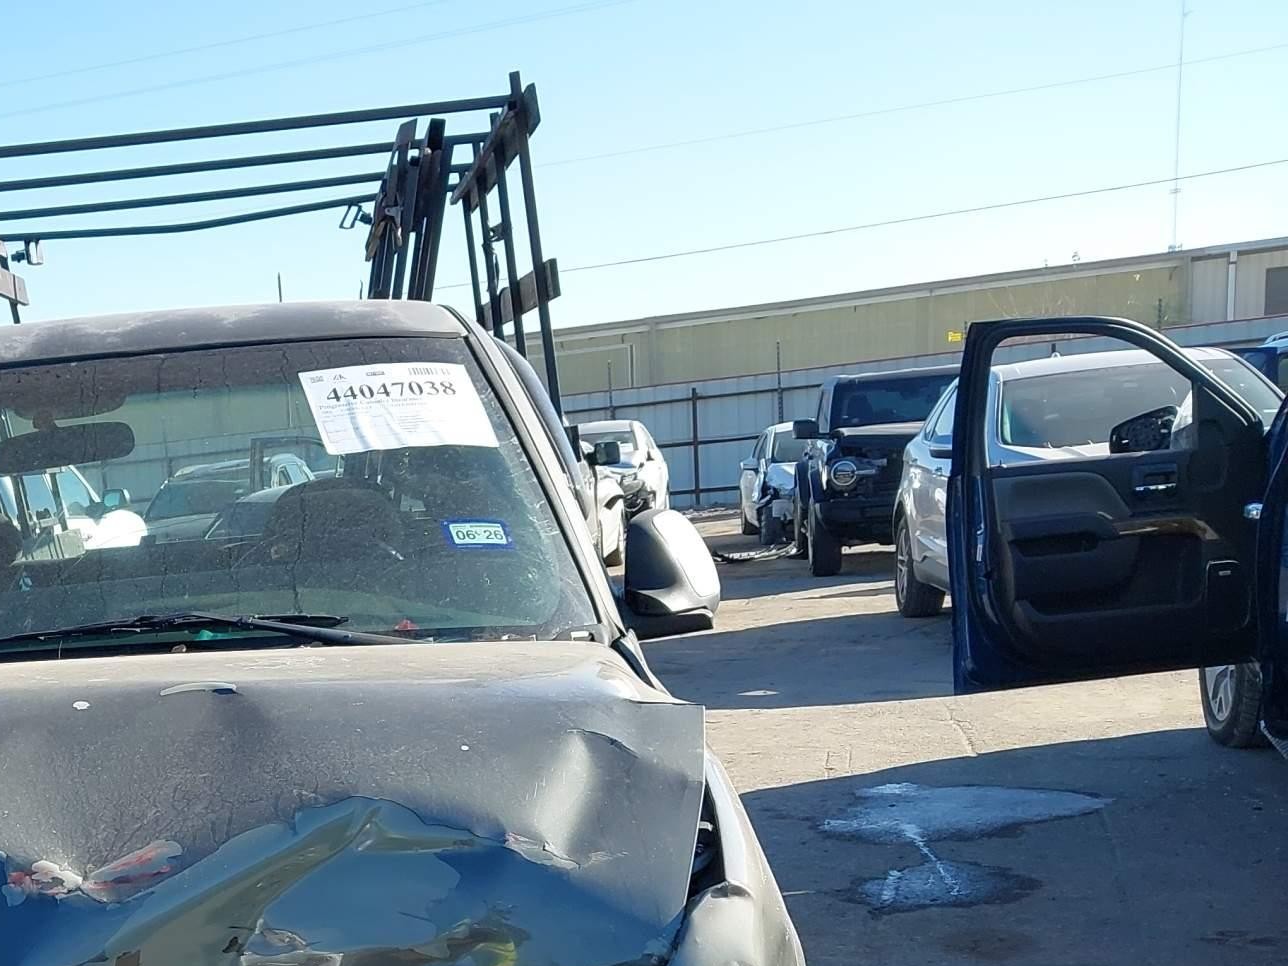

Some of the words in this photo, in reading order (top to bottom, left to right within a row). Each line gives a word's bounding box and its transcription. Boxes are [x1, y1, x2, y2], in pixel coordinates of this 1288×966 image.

[326, 380, 457, 402] 44047038
[455, 529, 476, 541] 06
[483, 529, 504, 541] 26
